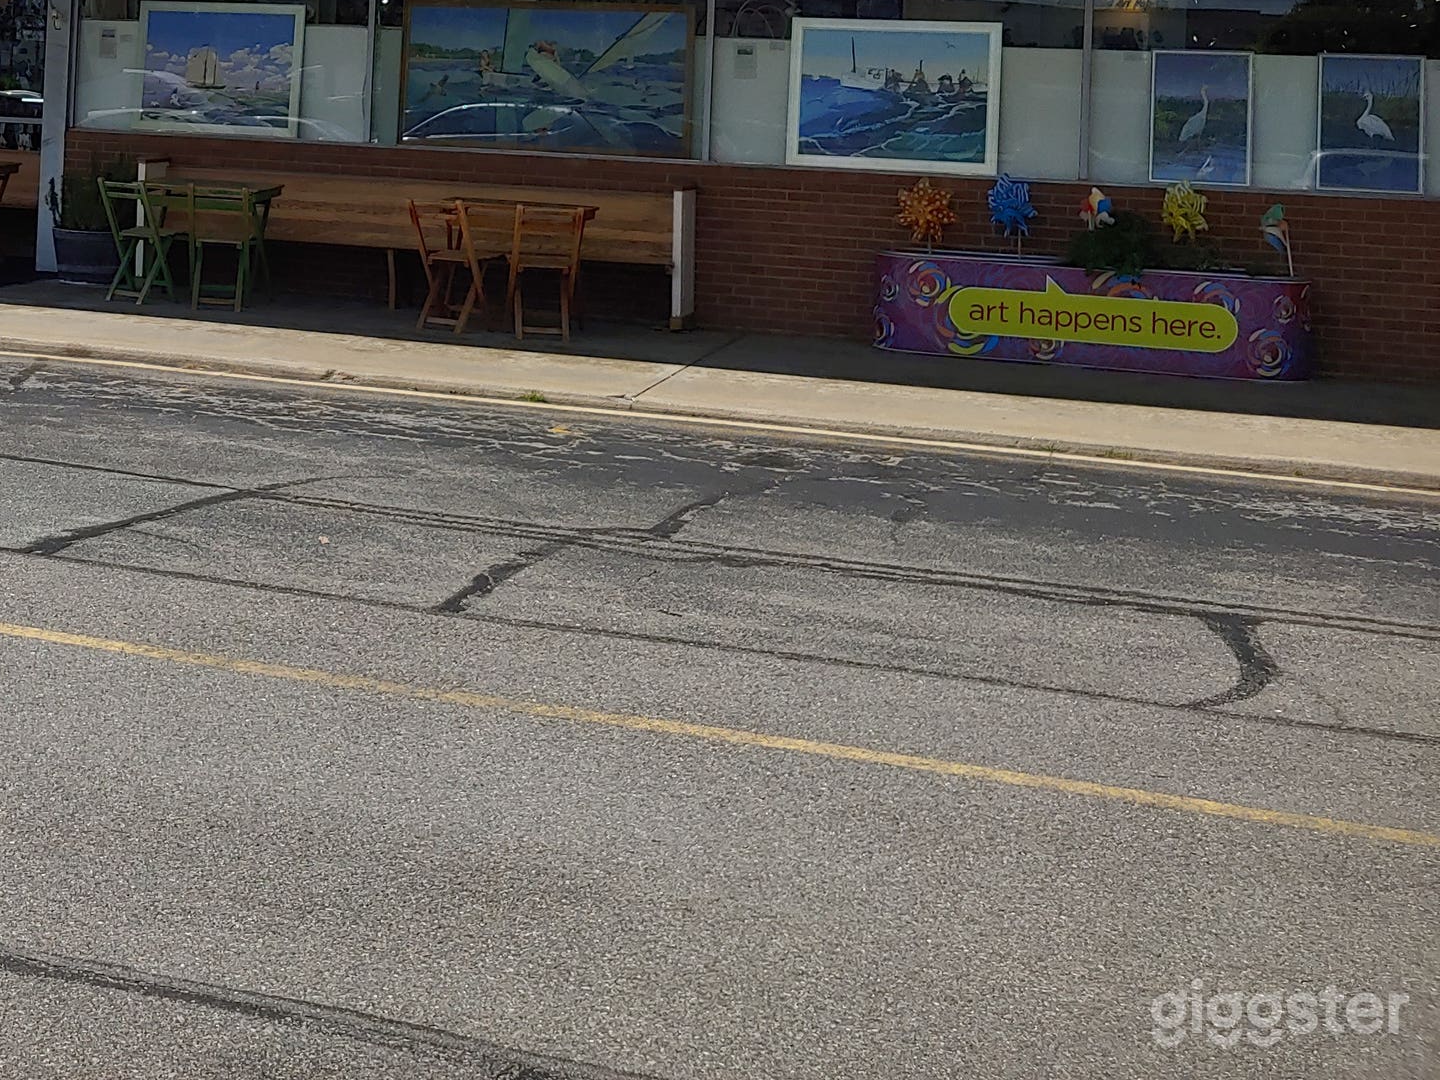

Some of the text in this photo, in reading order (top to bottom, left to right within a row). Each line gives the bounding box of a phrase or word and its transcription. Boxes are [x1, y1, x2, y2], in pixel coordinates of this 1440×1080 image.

[969, 300, 1223, 340] art happens here.
